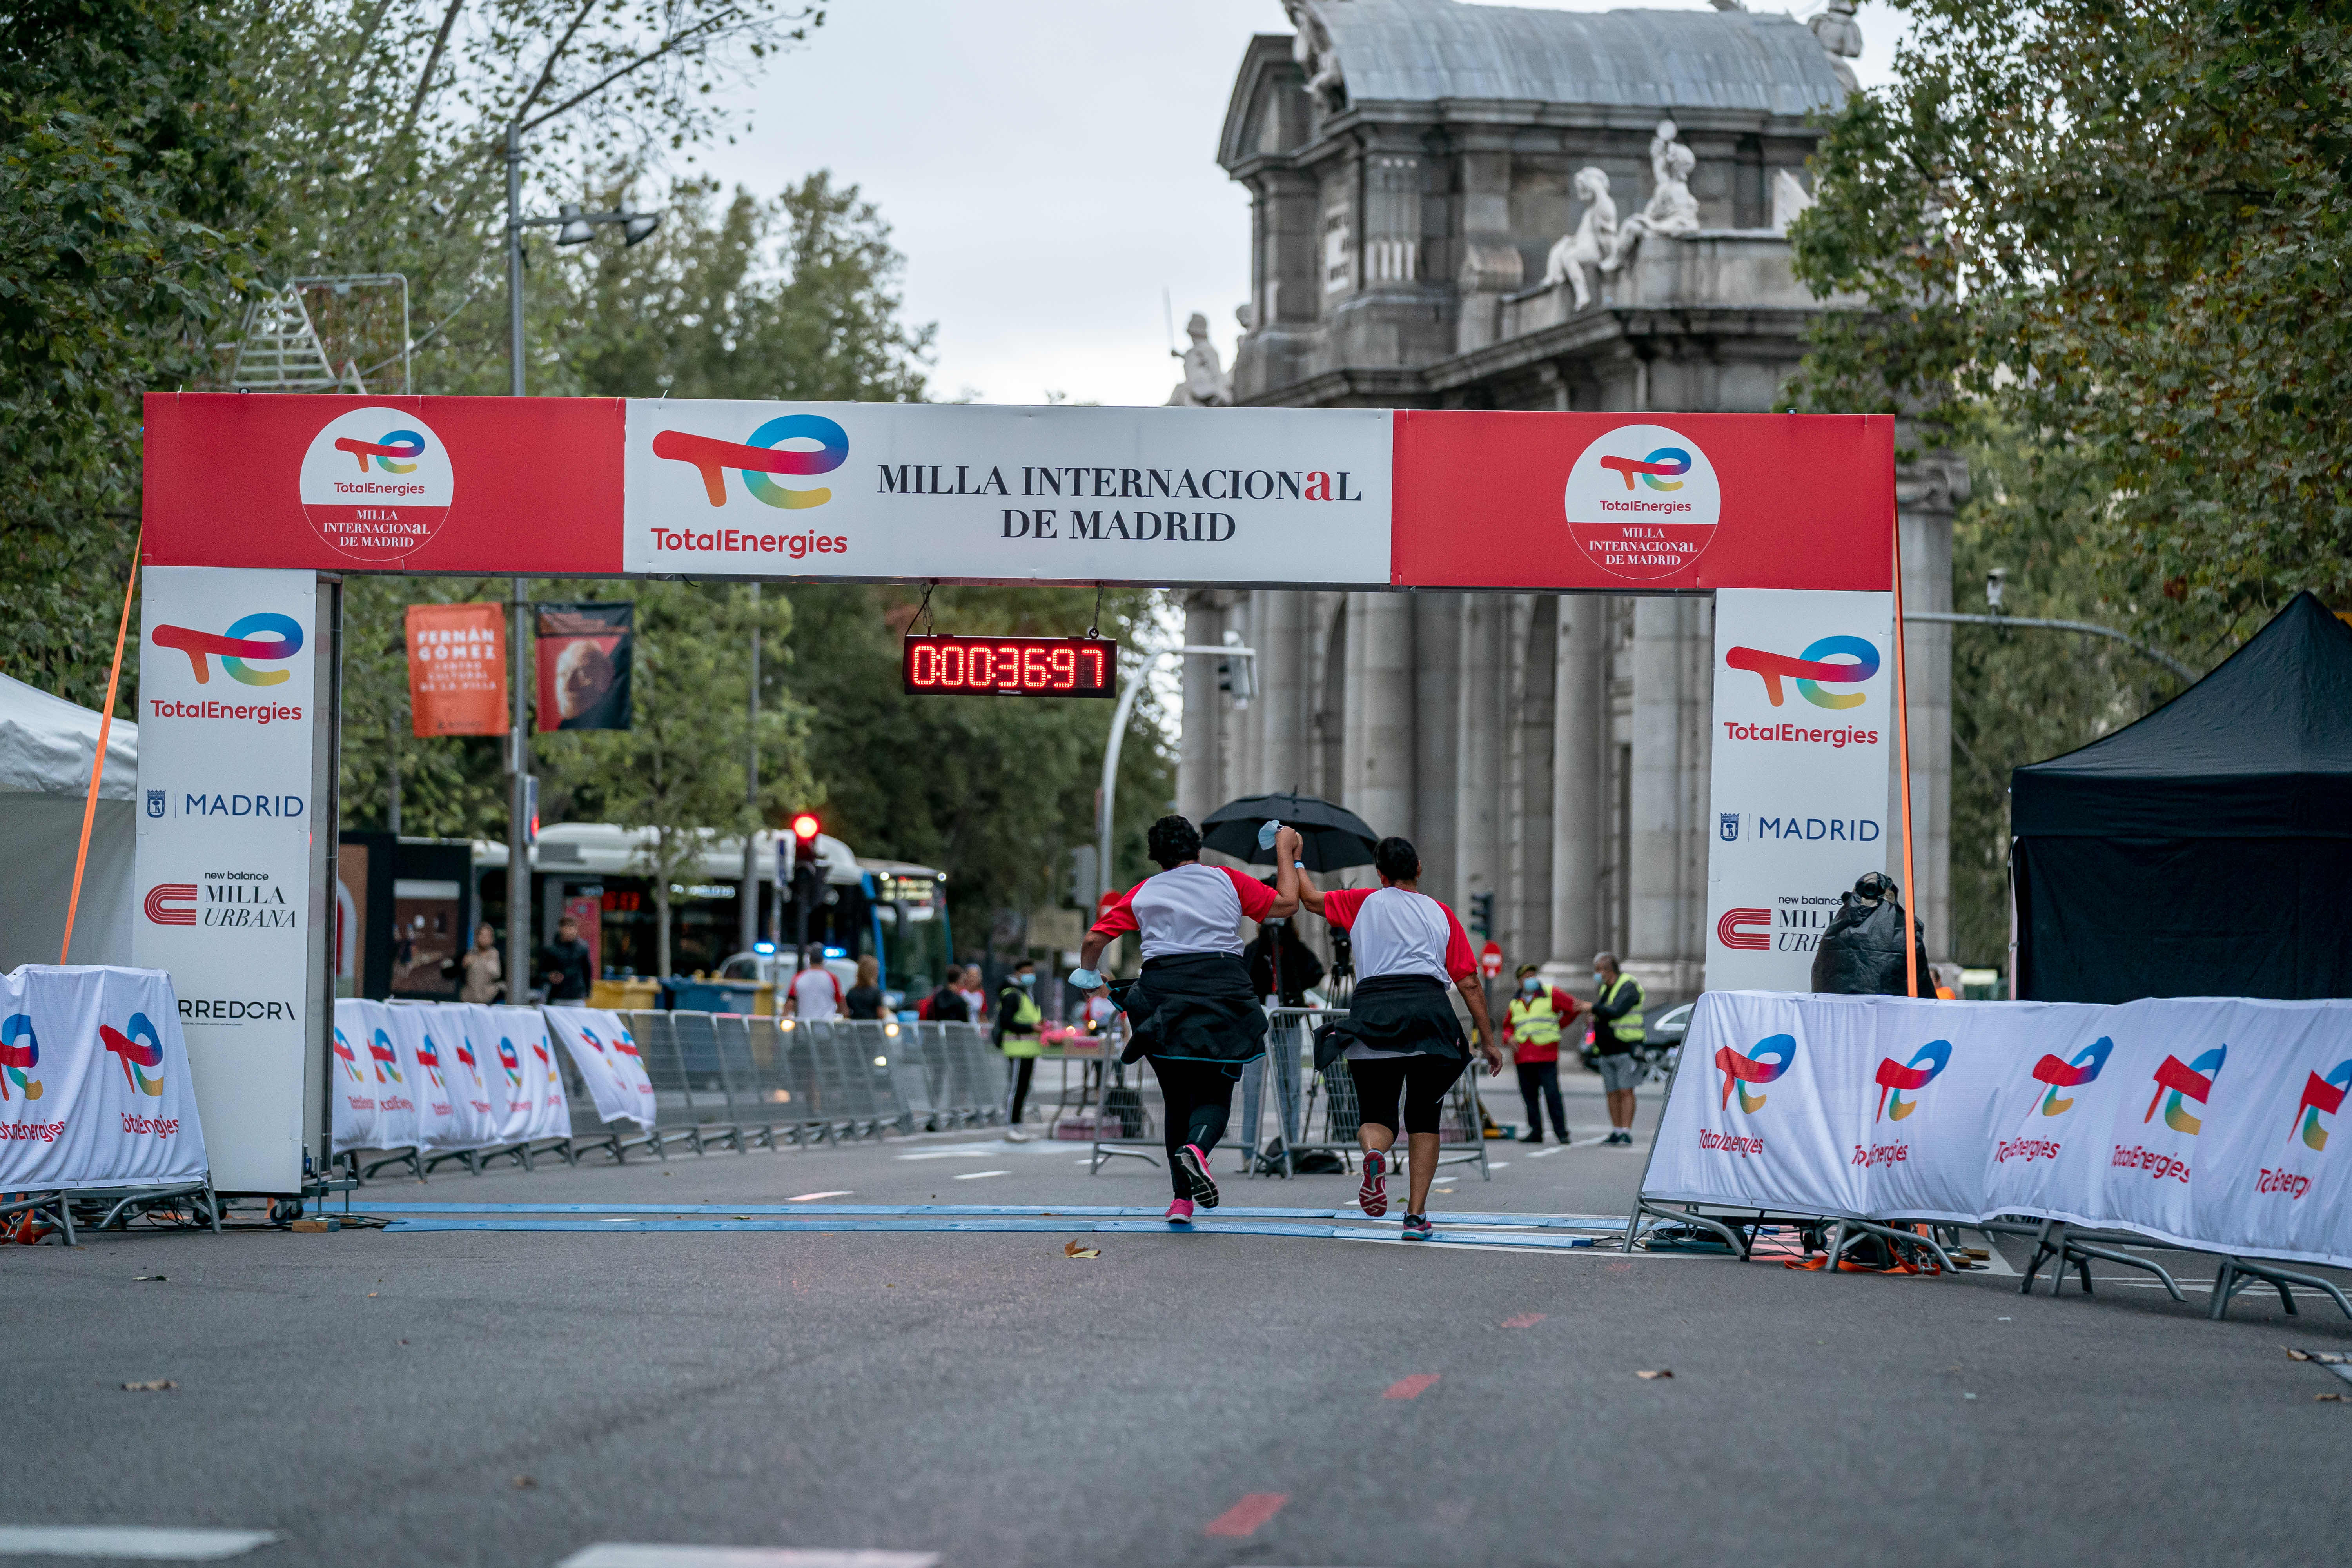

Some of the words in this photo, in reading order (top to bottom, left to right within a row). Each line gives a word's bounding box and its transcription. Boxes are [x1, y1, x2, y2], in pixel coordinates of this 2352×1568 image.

[334, 482, 425, 497] TotalEnergies
[877, 465, 1011, 495] MILLA
[356, 510, 398, 521] MILLA
[1599, 500, 1691, 515] TotalEnergies
[1000, 509, 1058, 539] DE
[1069, 510, 1236, 542] MADRID
[1622, 528, 1665, 538] MILLA
[340, 536, 358, 546] DE
[361, 536, 414, 547] MADRID
[650, 528, 847, 559] TotalEnergies
[1605, 554, 1624, 564] DE
[1627, 555, 1681, 565] MADRID
[150, 700, 302, 725] TotalEnergies
[1724, 722, 1878, 748] TotalEnergies
[186, 793, 304, 817] MADRID
[1759, 817, 1880, 842] MADRID
[227, 871, 269, 880] balance
[205, 884, 286, 904] MILLA
[1802, 896, 1843, 906] balance
[204, 908, 298, 928] URBANA
[1778, 909, 1836, 928] MIL
[1779, 933, 1823, 952] URB
[0, 1118, 65, 1142] otalEnergies
